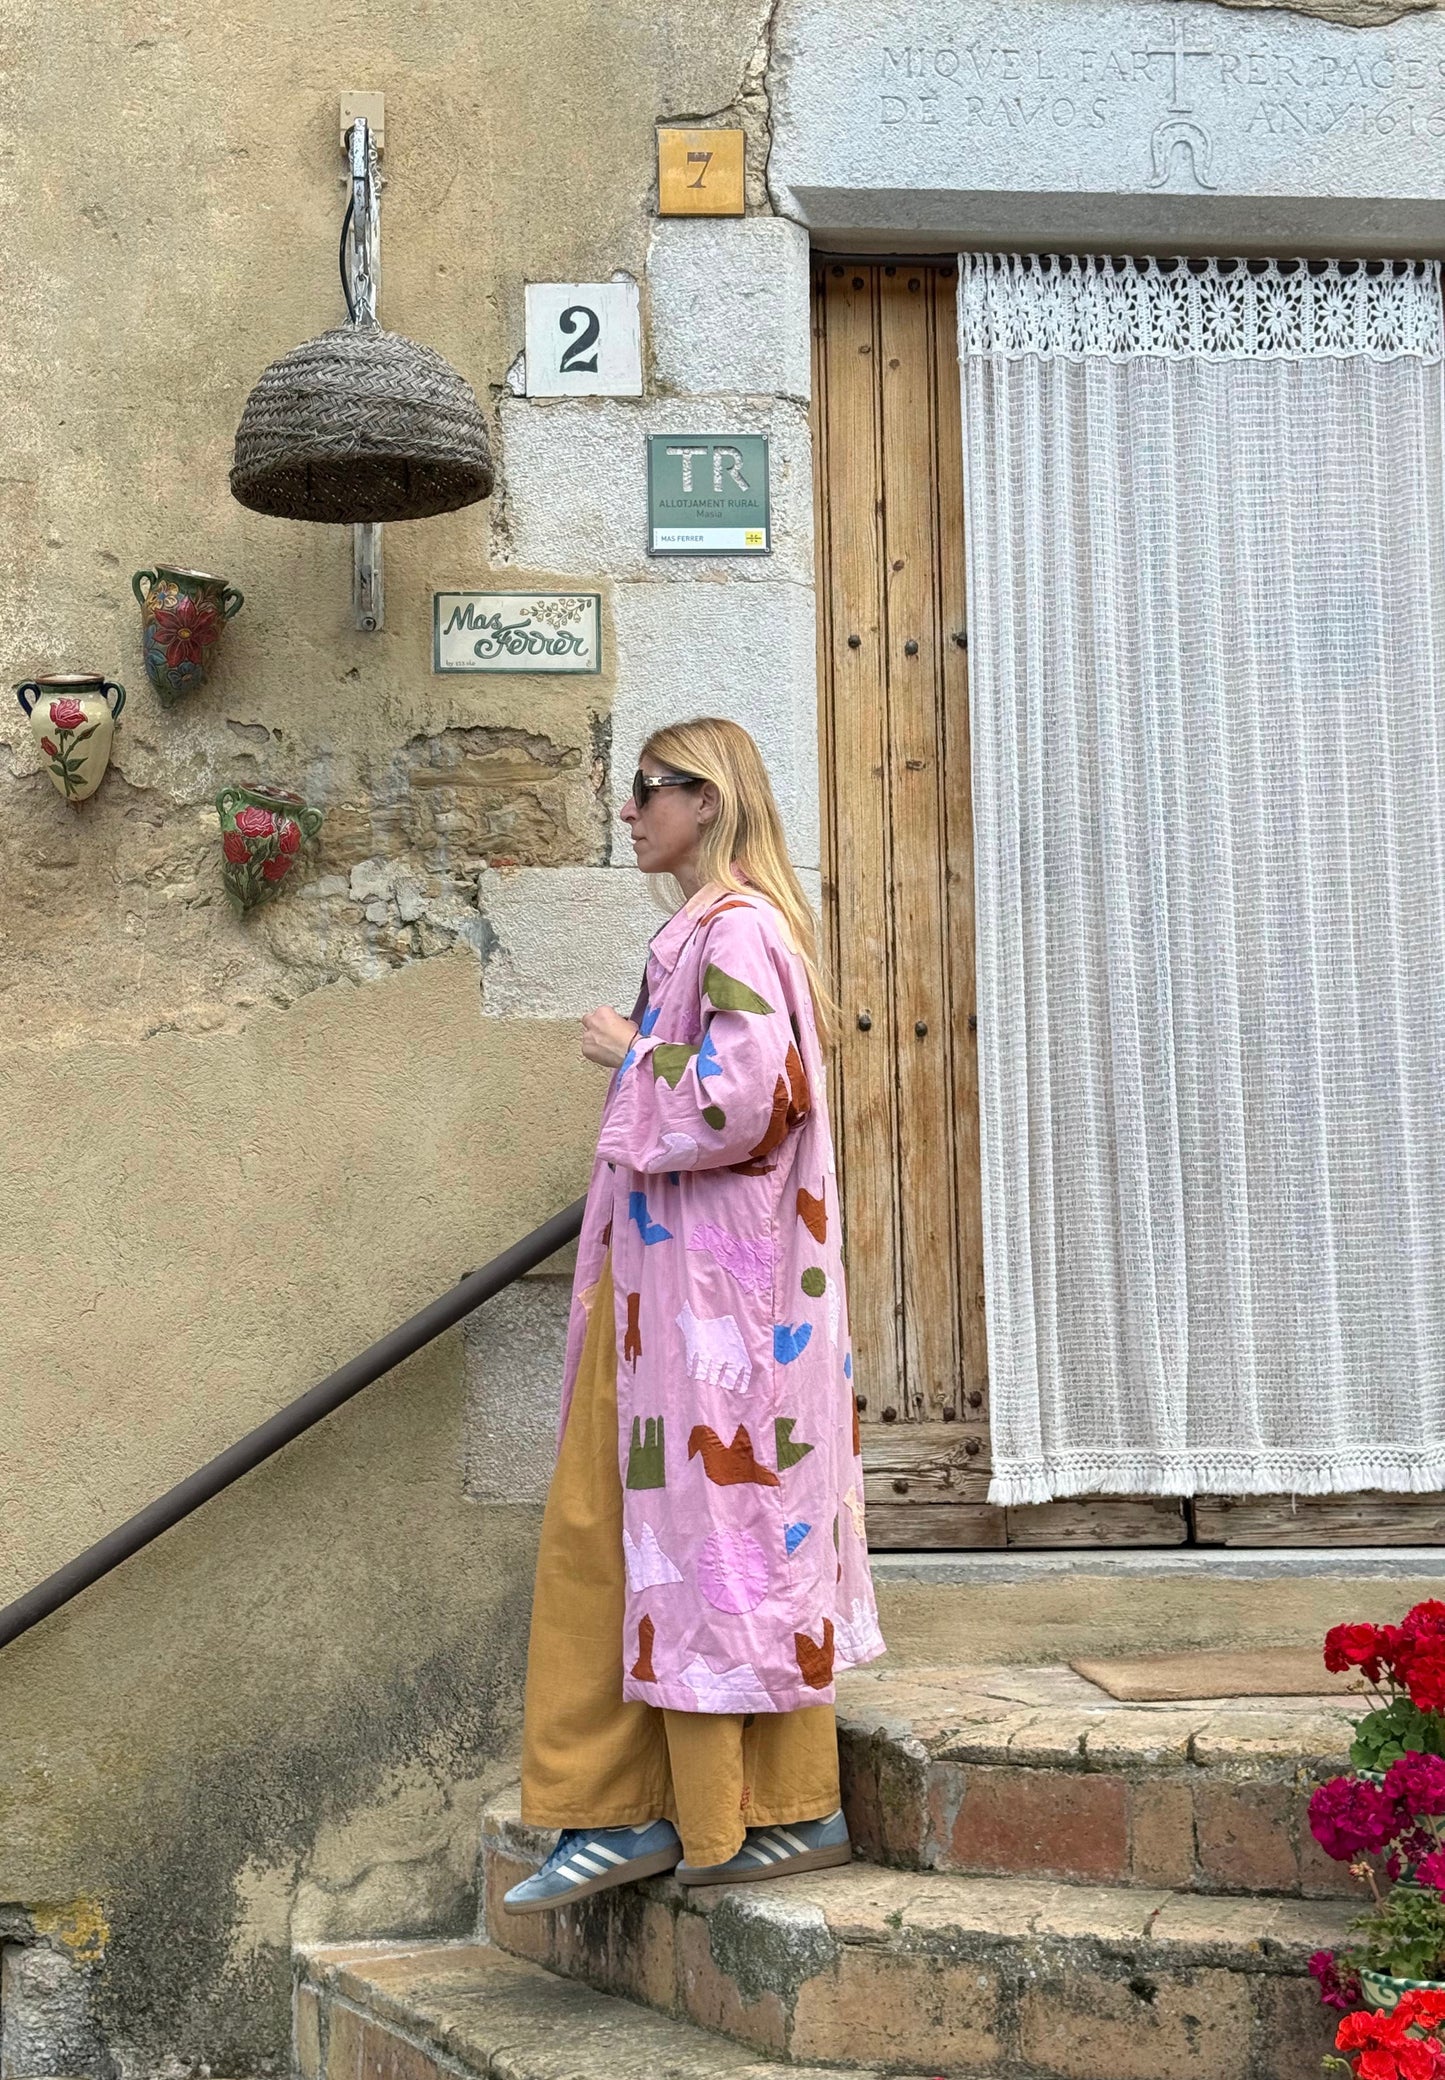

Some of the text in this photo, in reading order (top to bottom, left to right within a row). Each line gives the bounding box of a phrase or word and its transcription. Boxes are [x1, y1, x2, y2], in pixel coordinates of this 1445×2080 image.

[879, 95, 942, 125] DE
[686, 152, 714, 189] 7
[559, 305, 601, 373] 2
[666, 445, 750, 492] TR
[659, 499, 759, 508] ALLOTJAMENT RURAL
[443, 602, 503, 635] Mas
[474, 618, 589, 659] Ferrer
